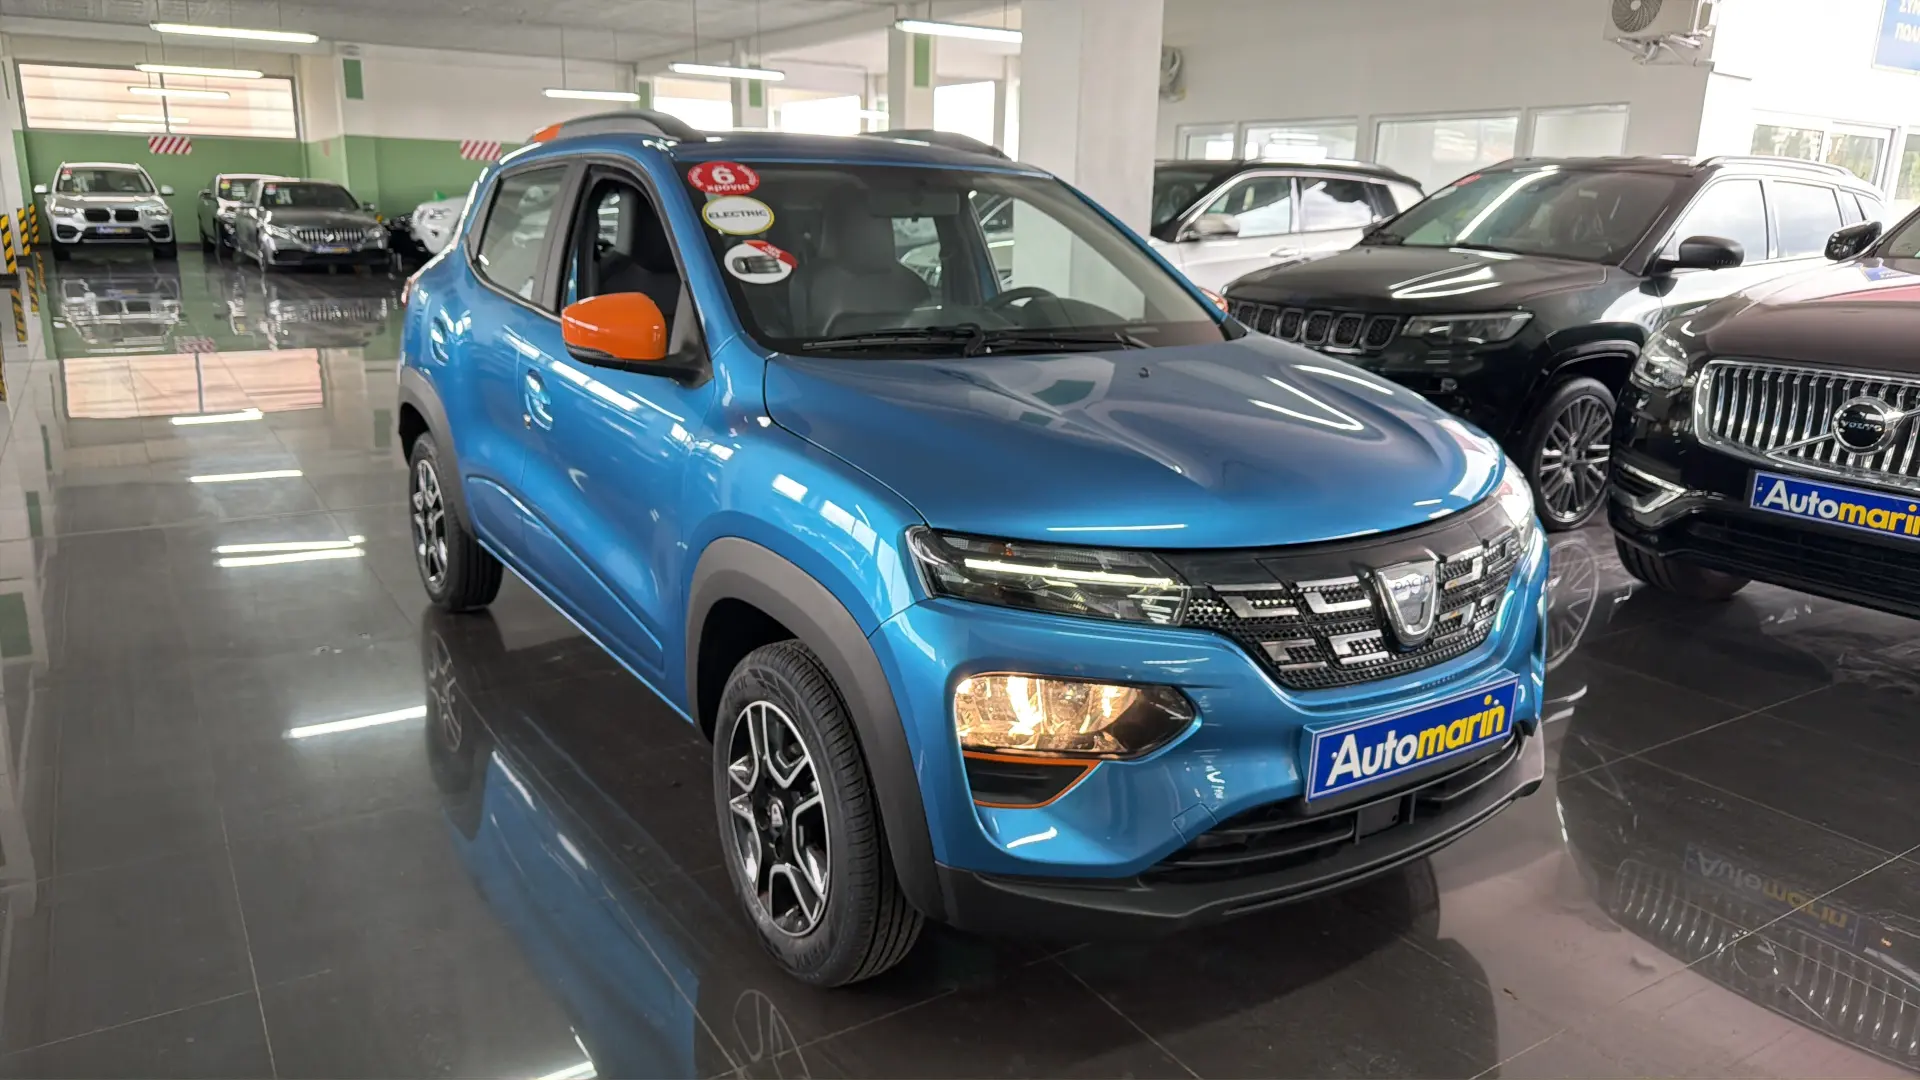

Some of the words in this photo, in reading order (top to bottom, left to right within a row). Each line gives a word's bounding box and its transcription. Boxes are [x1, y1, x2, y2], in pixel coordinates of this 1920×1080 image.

[711, 166, 736, 184] 6
[708, 210, 768, 219] ELECTRIC
[1840, 419, 1882, 433] VOLVO
[1394, 574, 1431, 591] DACIA
[1325, 694, 1505, 787] Automarin
